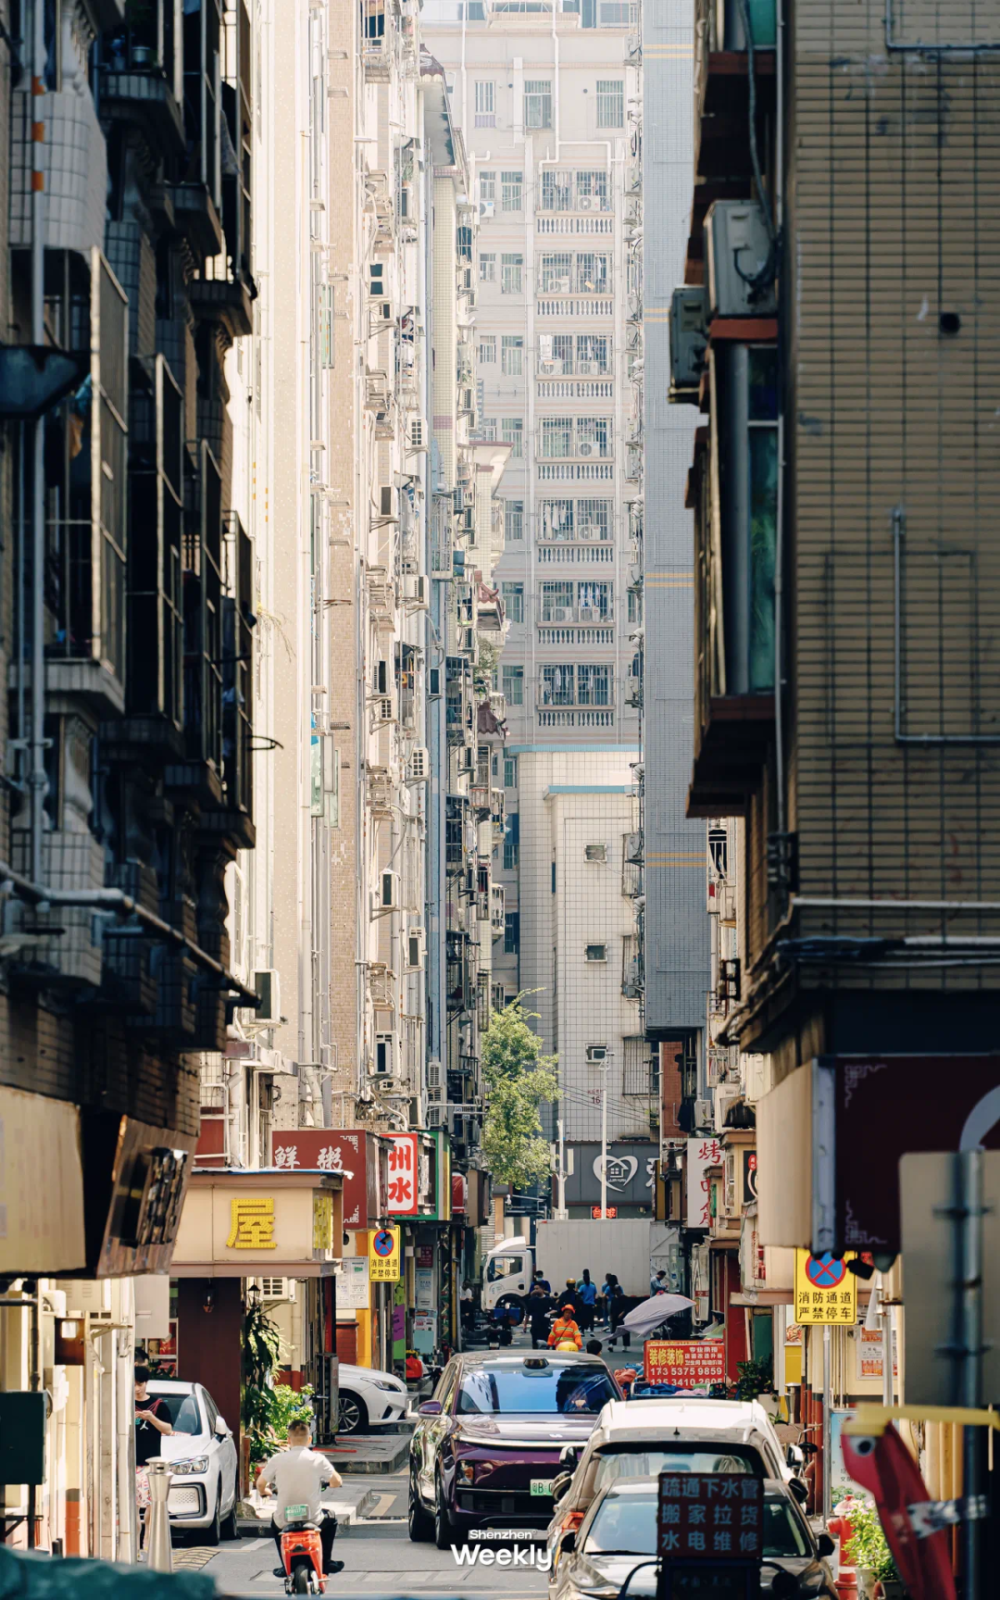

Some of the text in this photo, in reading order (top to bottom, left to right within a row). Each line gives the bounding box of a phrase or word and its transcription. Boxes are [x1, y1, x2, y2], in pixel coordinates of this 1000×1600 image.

[226, 1198, 277, 1249] 屋
[371, 1259, 398, 1267] 消防通道
[371, 1269, 398, 1277] 严禁停车
[798, 1291, 852, 1304] 消防通道
[798, 1307, 852, 1319] 严禁停车
[649, 1348, 684, 1366] 装修装饰
[650, 1367, 722, 1376] 173 5375 9859
[661, 1477, 759, 1499] 疏通下水管
[661, 1504, 759, 1525] 搬家拉货
[661, 1530, 758, 1551] 水电维修
